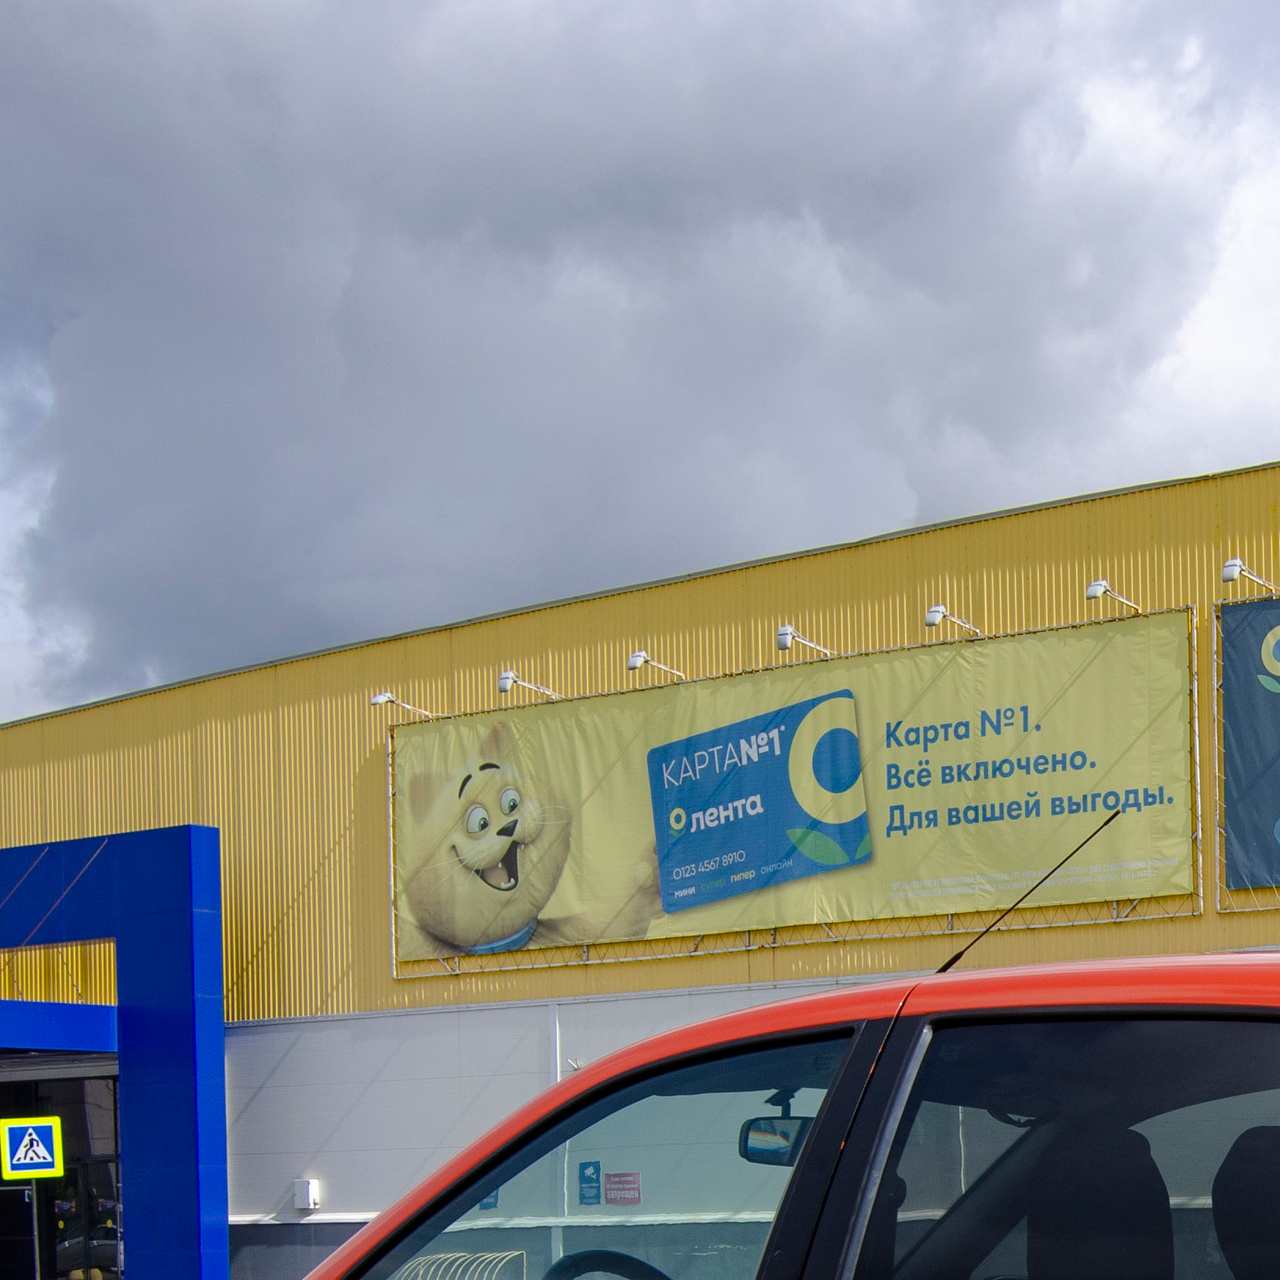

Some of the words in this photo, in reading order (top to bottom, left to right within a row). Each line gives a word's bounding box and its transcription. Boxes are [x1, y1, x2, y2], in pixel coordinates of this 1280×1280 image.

[885, 720, 970, 753] Карта
[886, 759, 932, 790] Всё
[941, 750, 1096, 785] включено.
[690, 793, 764, 834] лента
[886, 804, 938, 838] Для
[948, 791, 1041, 827] вашей
[1051, 785, 1174, 816] выгоды.
[673, 863, 696, 880] 0123
[698, 857, 720, 873] 4567
[722, 850, 746, 867] 8910
[674, 886, 696, 899] мини
[730, 869, 756, 883] гипер
[760, 858, 793, 875] онлайн
